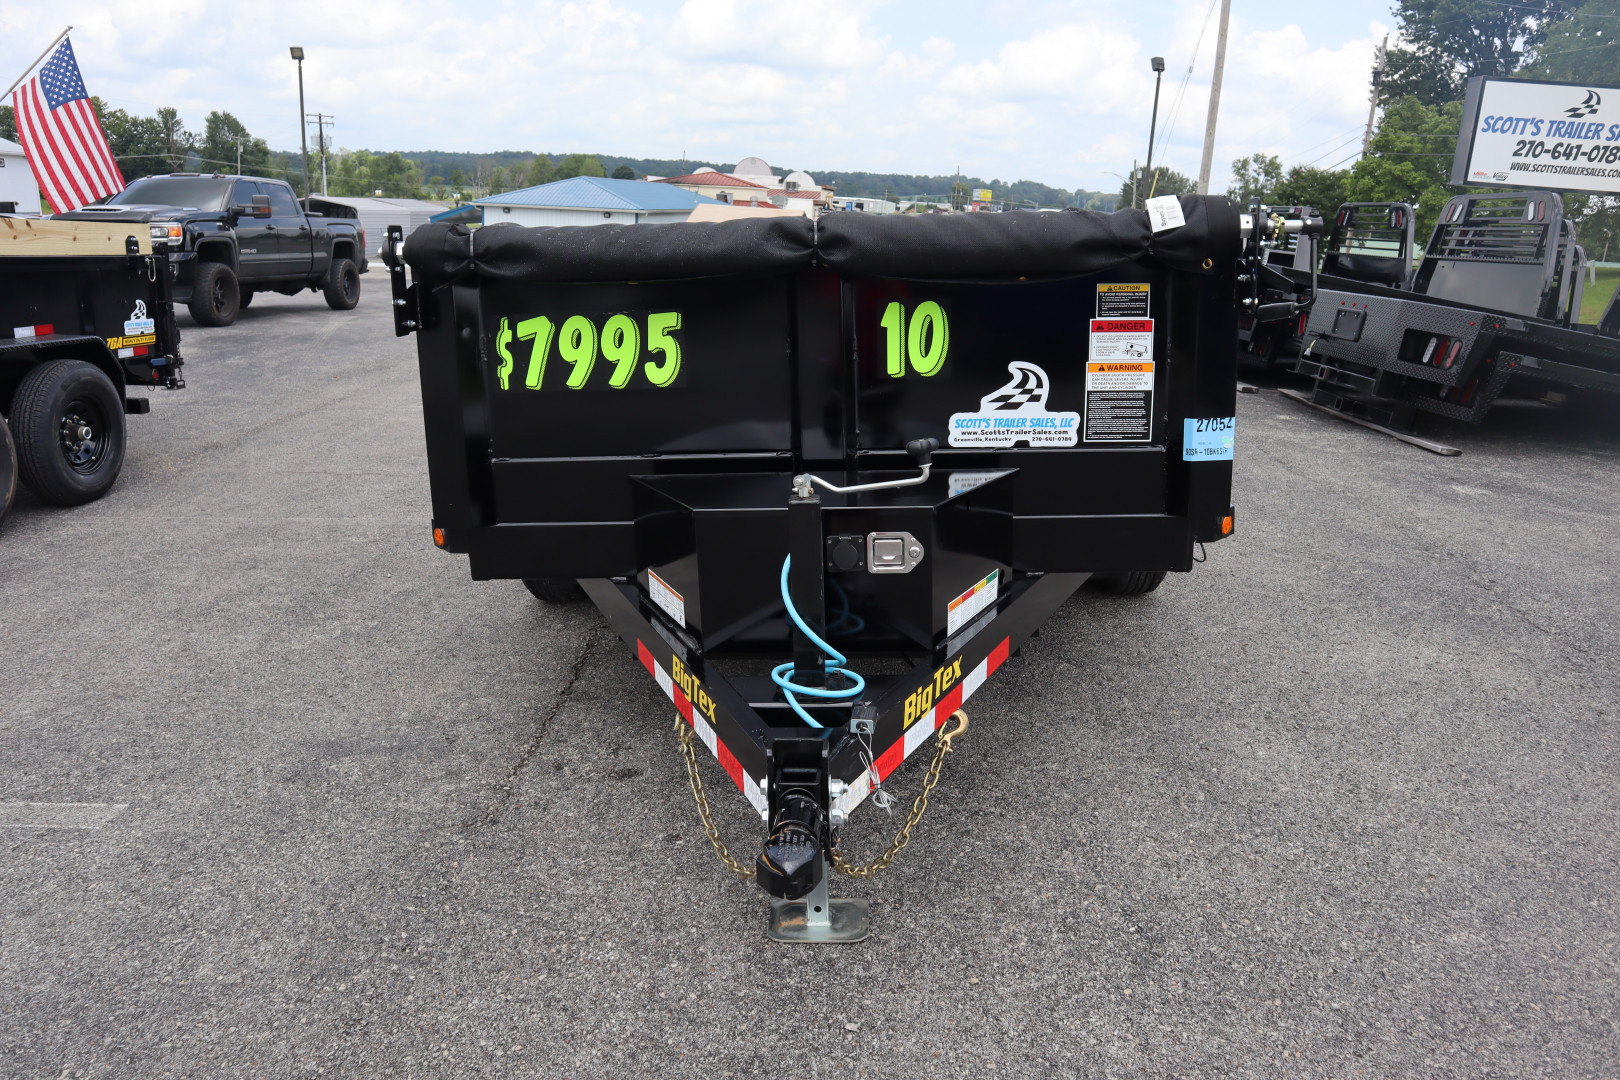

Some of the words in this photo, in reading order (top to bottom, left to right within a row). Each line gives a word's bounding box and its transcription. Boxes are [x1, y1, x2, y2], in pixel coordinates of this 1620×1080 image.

[1481, 115, 1545, 137] SCOTT'S
[1546, 120, 1605, 140] TRAILER
[1512, 139, 1620, 164] 270-641-078
[880, 300, 950, 378] 10
[1107, 322, 1146, 331] DANGER
[496, 311, 682, 391] $7995
[954, 417, 991, 429] SCOTT'S
[993, 417, 1028, 429] TRAILER
[1029, 417, 1058, 430] SALES,
[1060, 417, 1075, 428] LLC
